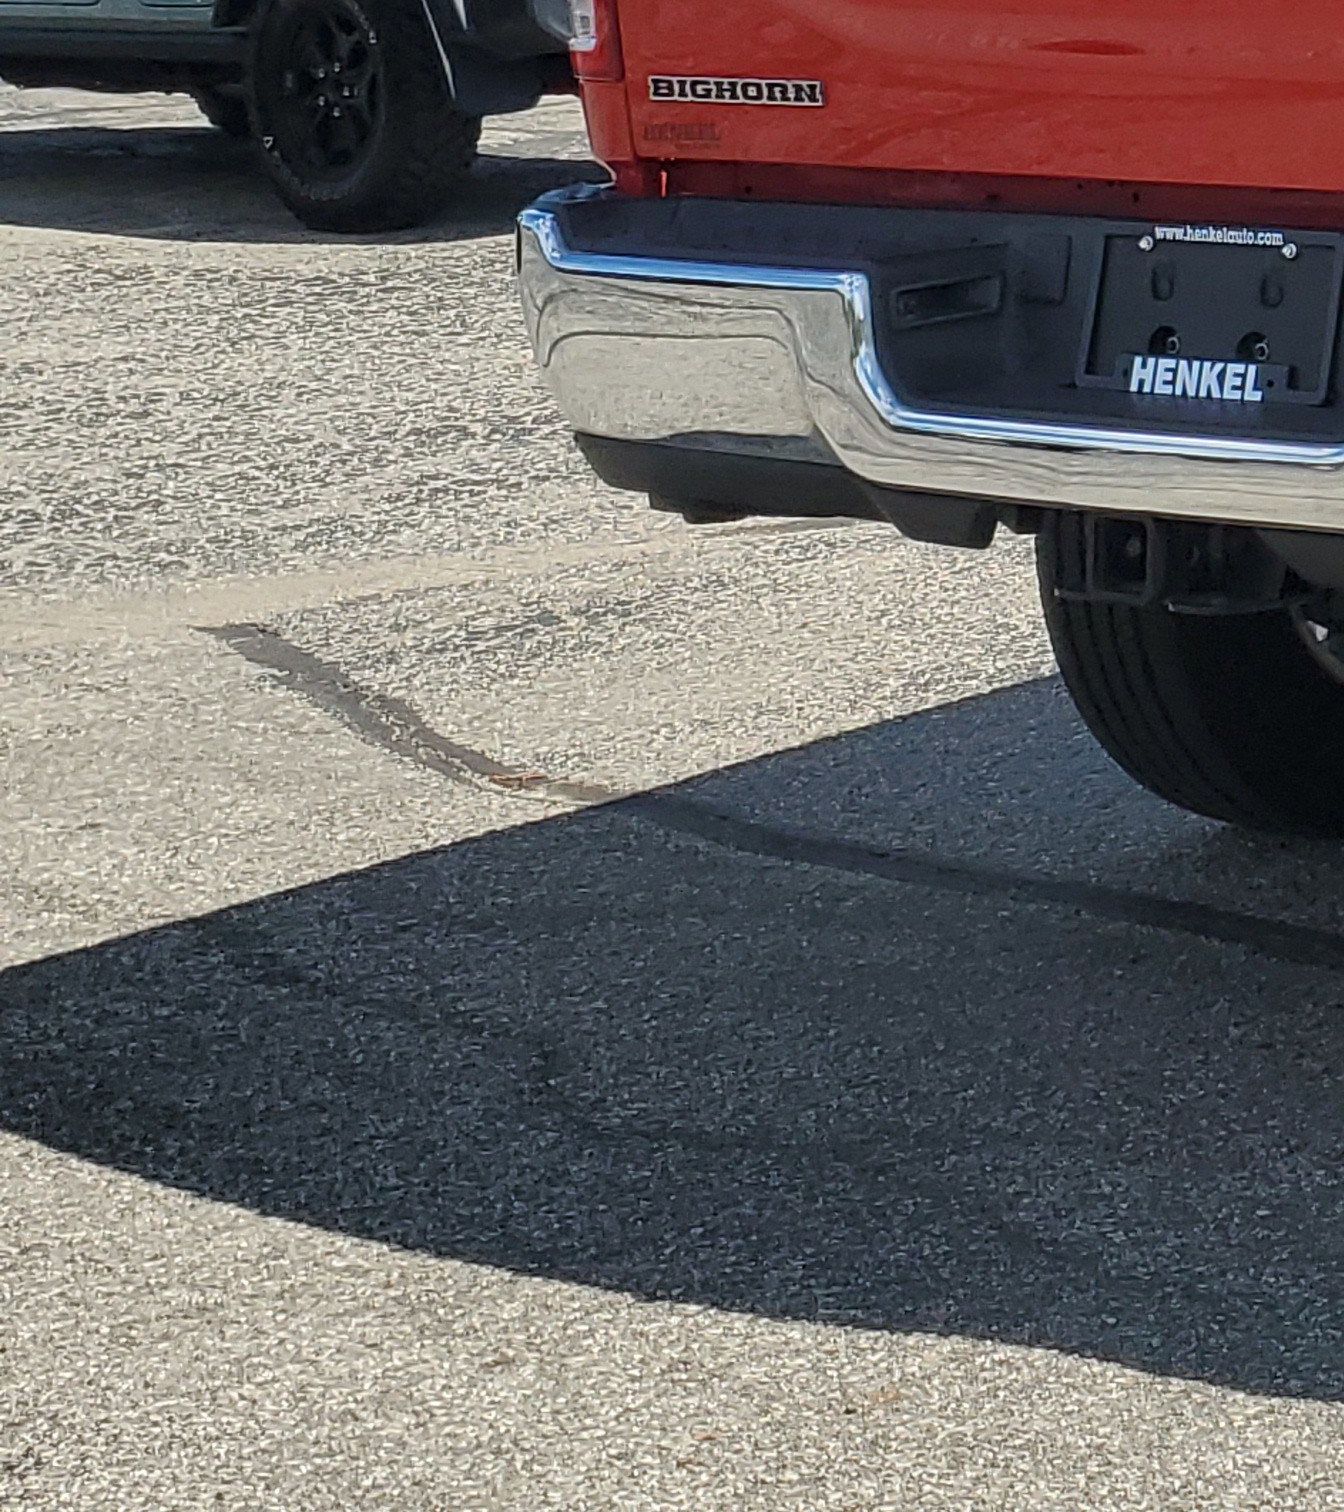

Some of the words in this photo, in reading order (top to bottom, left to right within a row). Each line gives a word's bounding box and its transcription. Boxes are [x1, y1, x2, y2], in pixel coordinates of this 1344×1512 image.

[650, 77, 822, 104] BIGHORN
[1153, 225, 1284, 246] www.henkelauto.com
[1129, 355, 1263, 402] HENKEL
